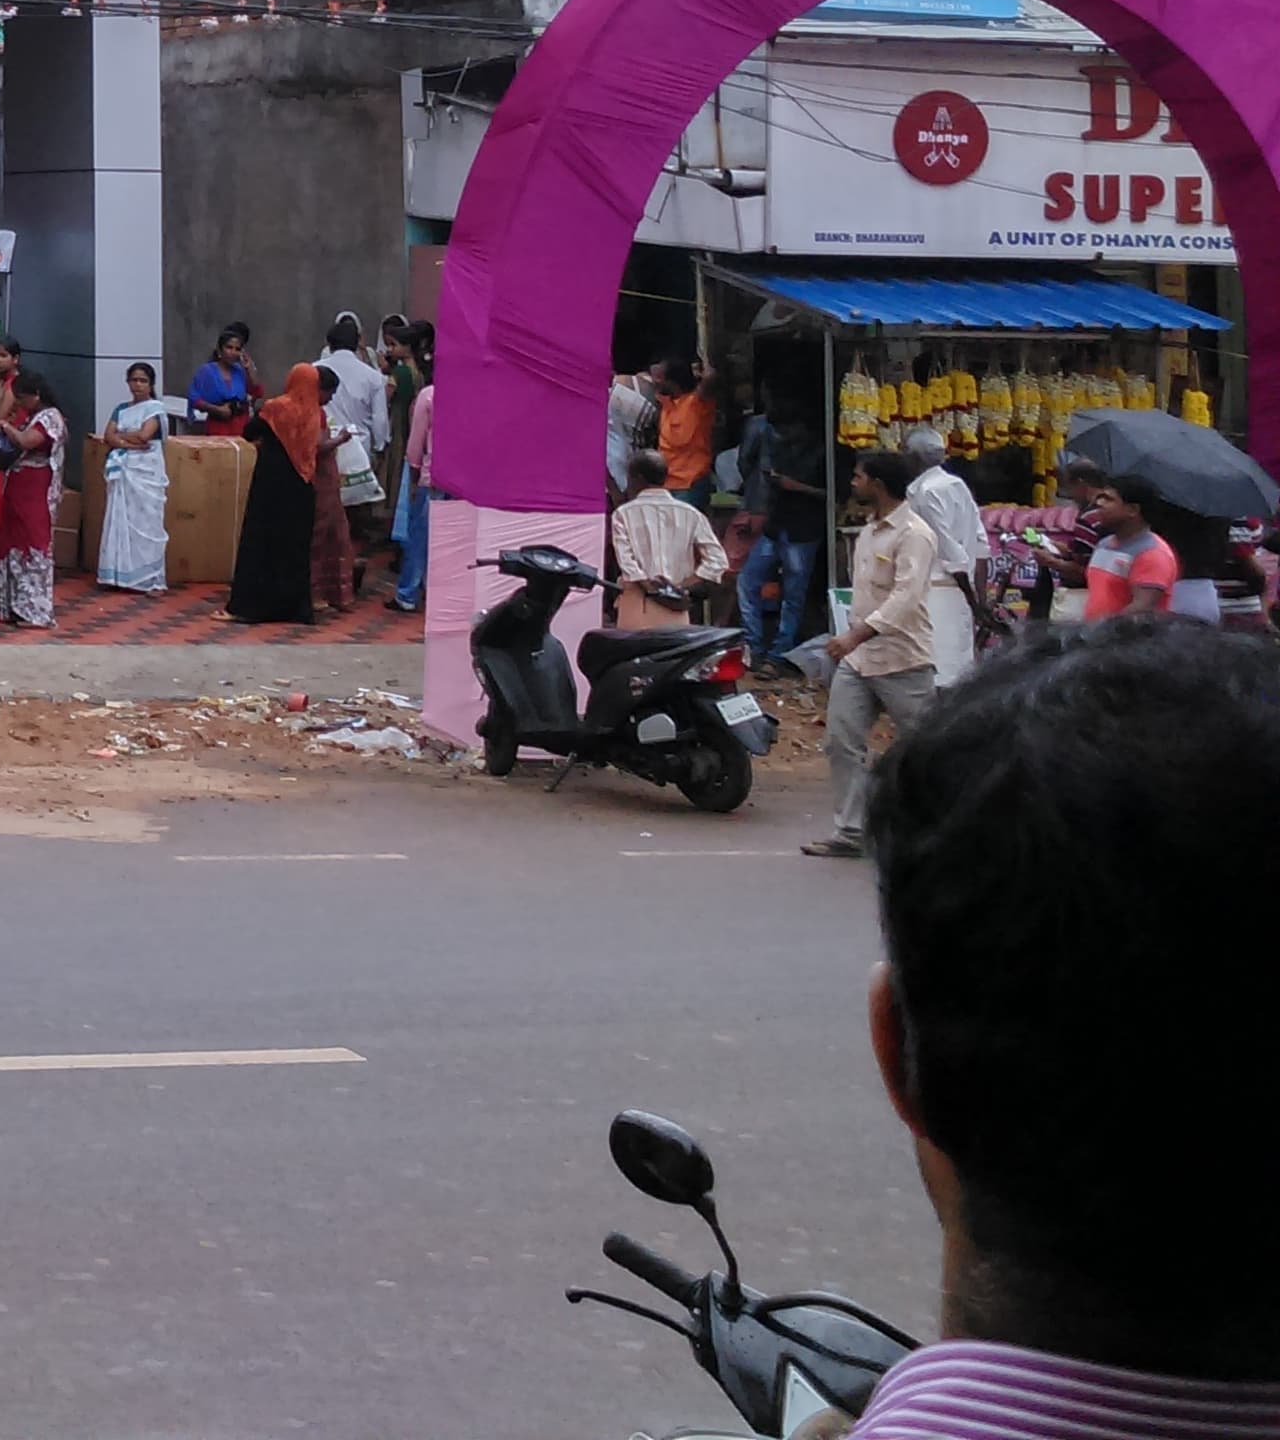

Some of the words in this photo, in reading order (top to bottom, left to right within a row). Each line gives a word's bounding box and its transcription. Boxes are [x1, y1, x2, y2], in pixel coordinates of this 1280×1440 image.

[918, 131, 968, 146] Dhanya
[988, 231, 1003, 245] A
[1007, 232, 1056, 246] UNIT
[1060, 233, 1087, 247] OF
[1091, 234, 1176, 248] DHANYA
